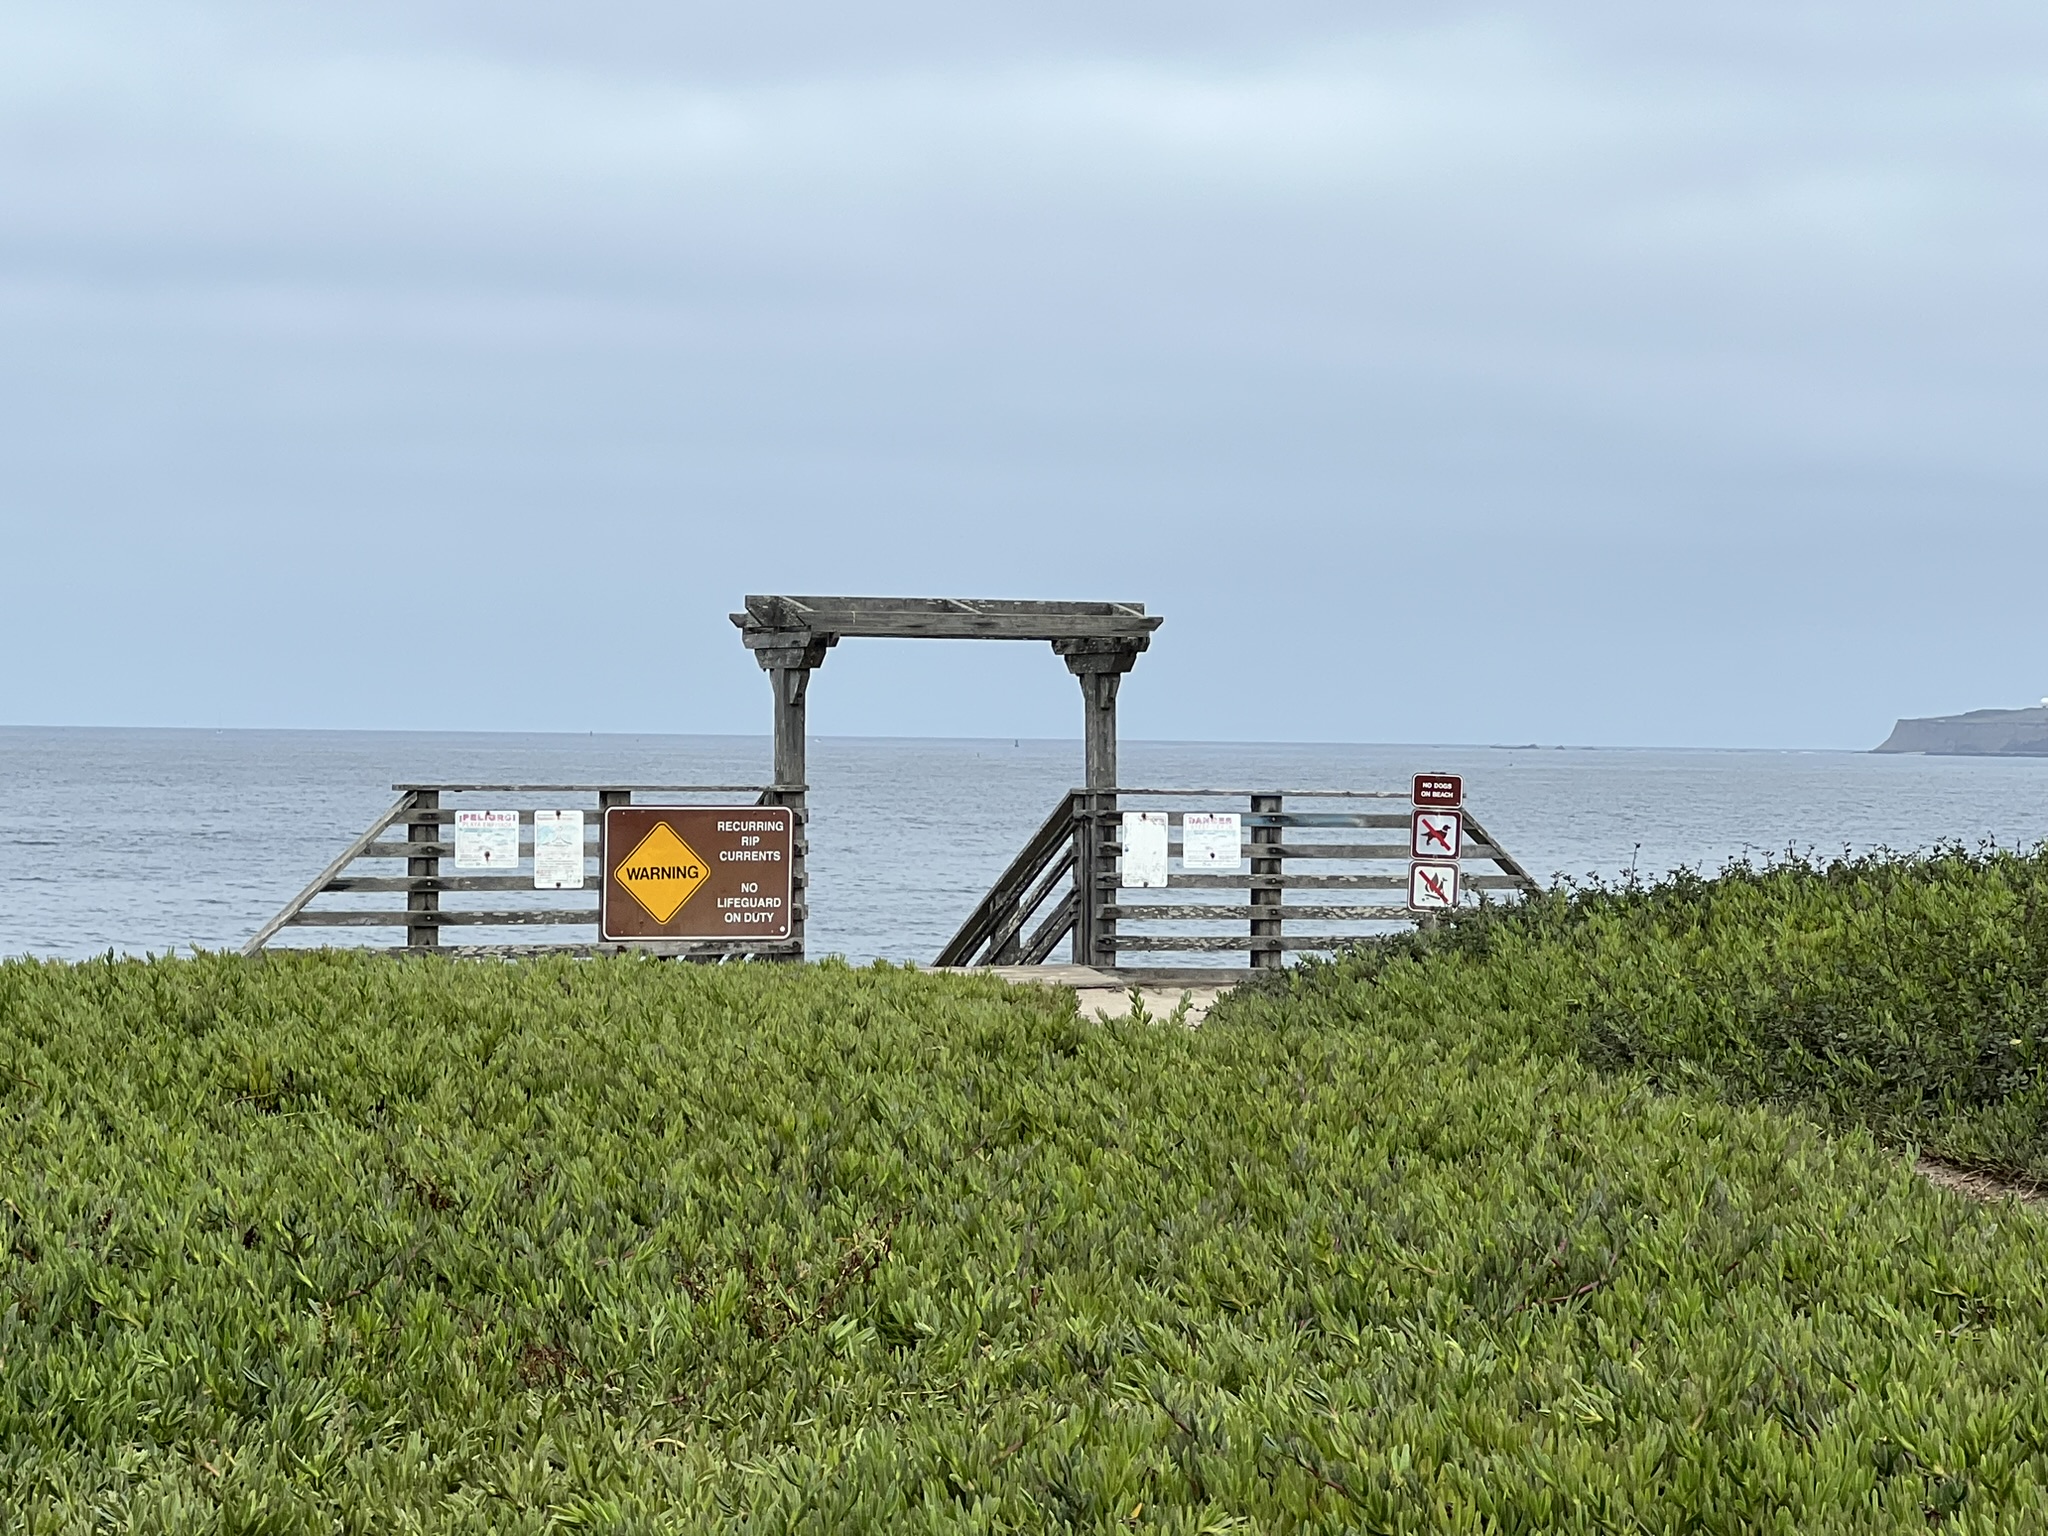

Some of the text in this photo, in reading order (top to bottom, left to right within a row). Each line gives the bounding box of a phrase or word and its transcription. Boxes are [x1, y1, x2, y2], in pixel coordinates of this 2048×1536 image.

[717, 821, 784, 832] RECURRING
[741, 836, 761, 847] RIP
[719, 850, 781, 862] CURRENTS
[626, 865, 699, 881] WARNING
[741, 882, 759, 893] NO
[717, 897, 782, 908] LIFEGUARD
[724, 912, 775, 924] ON DUTY
